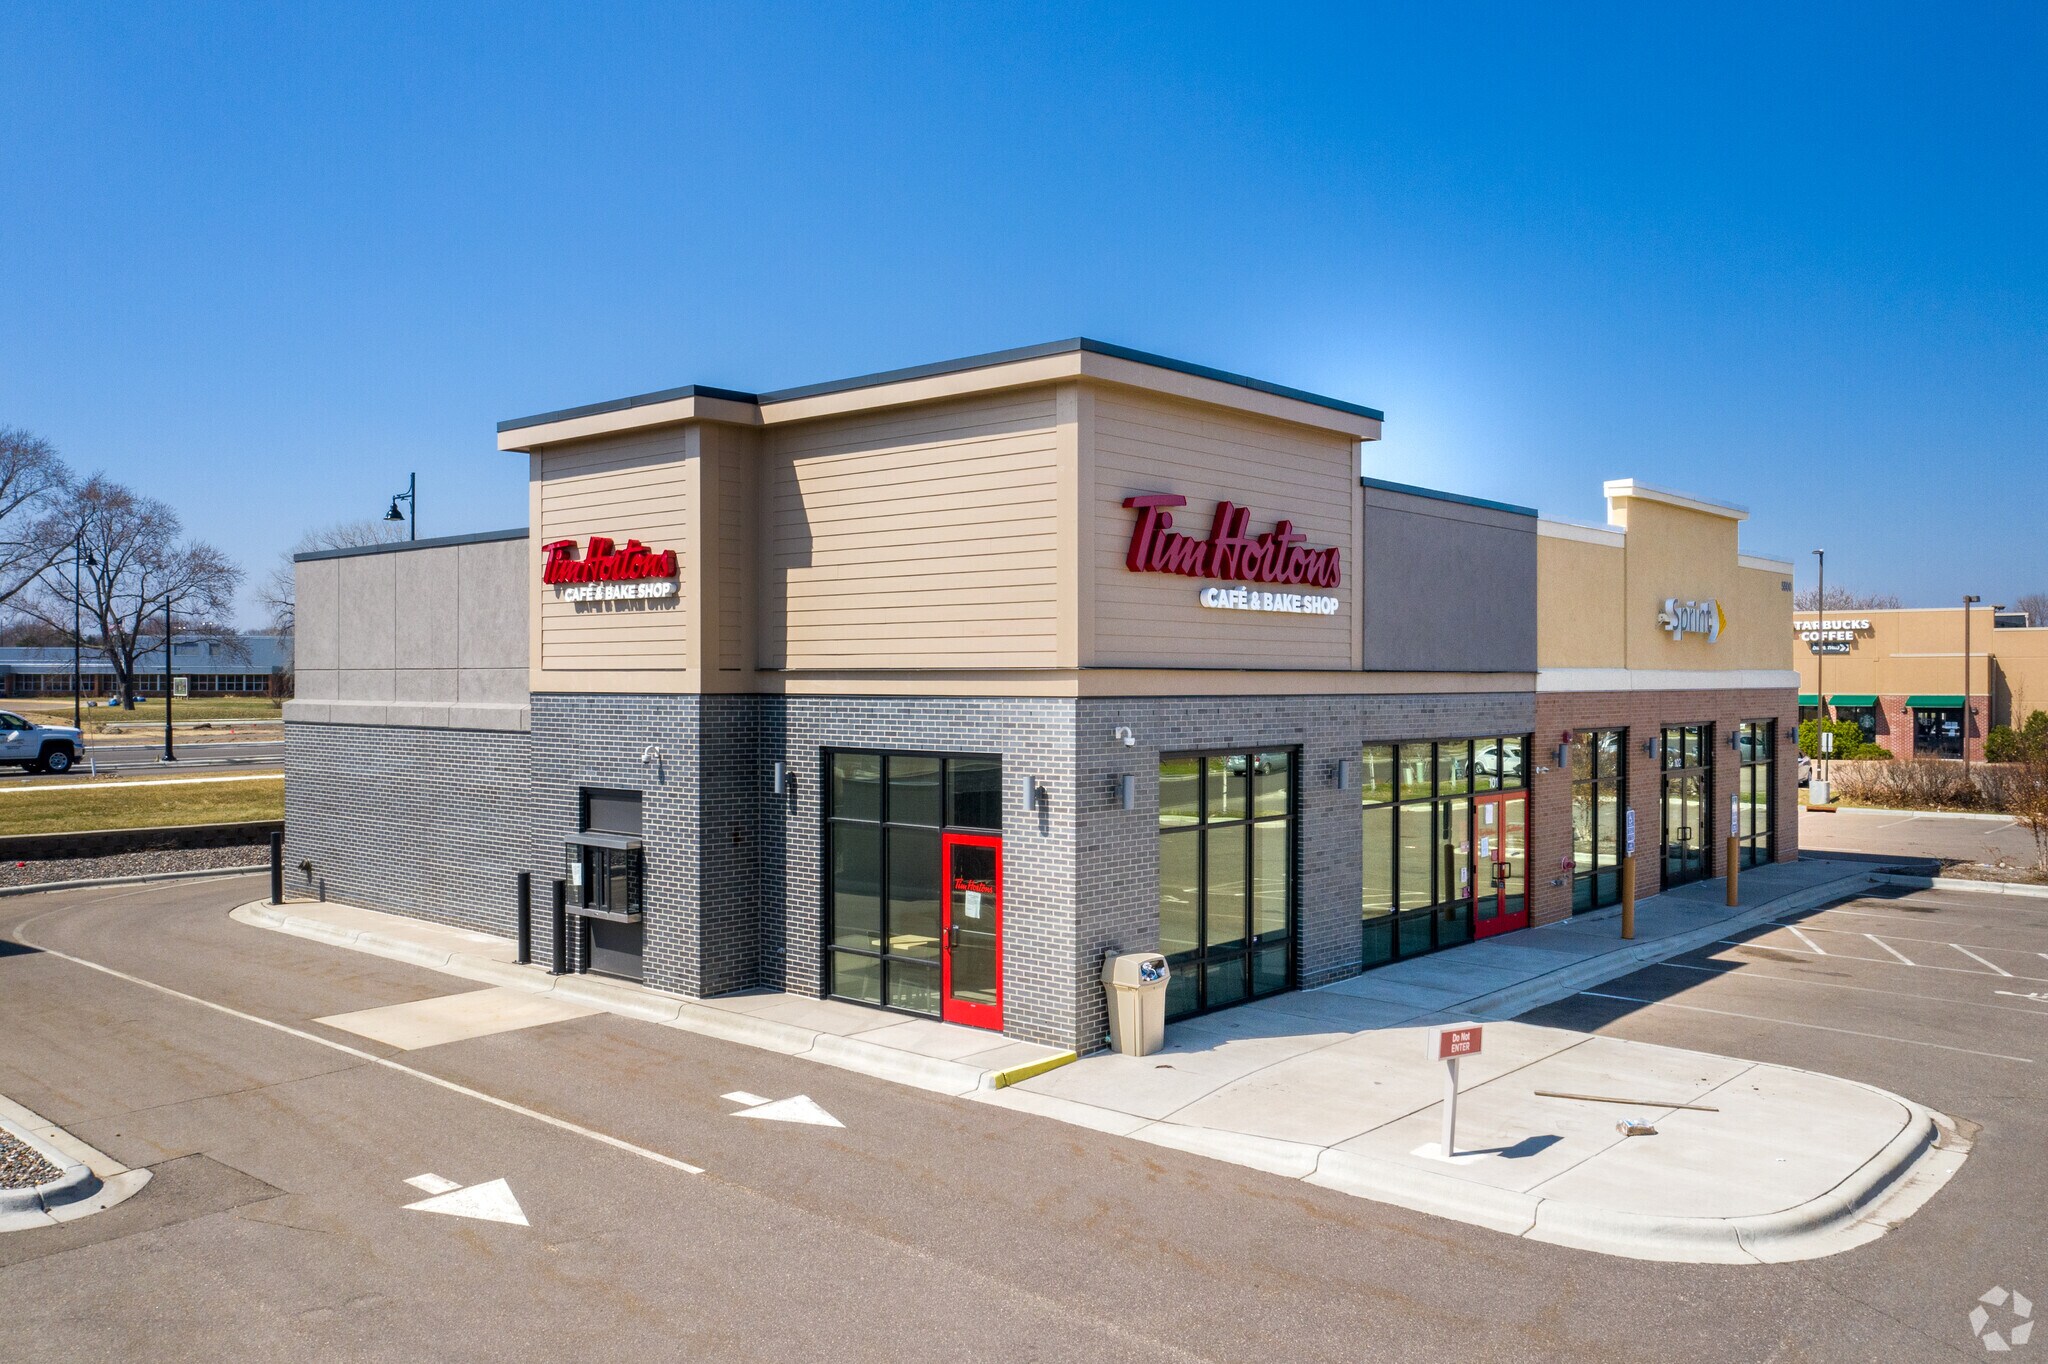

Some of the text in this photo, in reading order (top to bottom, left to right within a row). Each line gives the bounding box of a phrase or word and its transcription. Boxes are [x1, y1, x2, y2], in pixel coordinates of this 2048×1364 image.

[1122, 494, 1341, 588] Tim Hortons
[542, 536, 677, 584] Tim Hortons
[564, 582, 676, 602] CAFÉ & BAKE SHOP
[1200, 586, 1339, 615] CAFÉ & BAKE SHOP
[1665, 598, 1711, 640] Sprint
[1793, 620, 1870, 630] TARBUCKS
[1801, 631, 1854, 641] COFFEE
[955, 878, 993, 894] Tim Hortons
[1452, 1032, 1470, 1043] Do Not
[1451, 1042, 1470, 1053] ENTER
